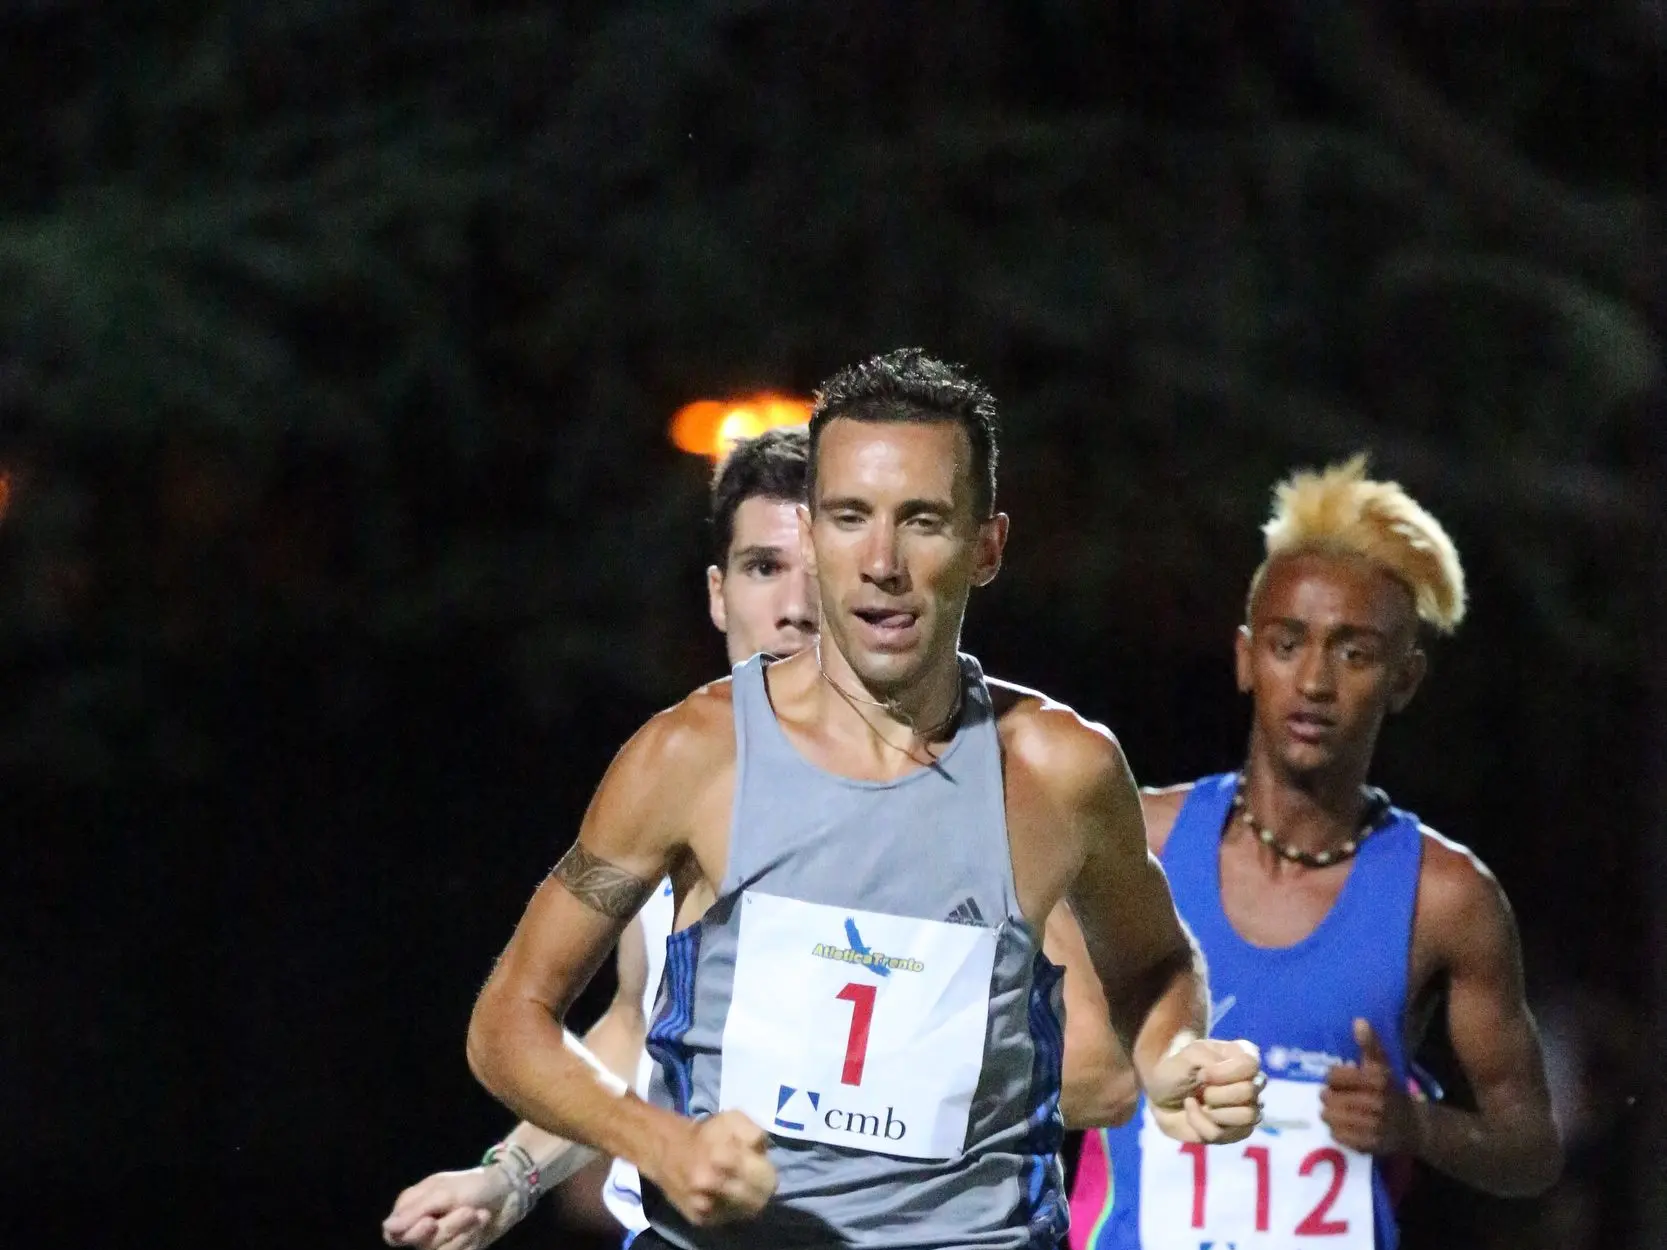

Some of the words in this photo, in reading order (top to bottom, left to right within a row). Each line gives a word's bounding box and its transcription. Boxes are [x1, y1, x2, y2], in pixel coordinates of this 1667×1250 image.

[835, 982, 877, 1087] 1
[824, 1106, 907, 1141] cmb
[1177, 1141, 1350, 1236] 112
